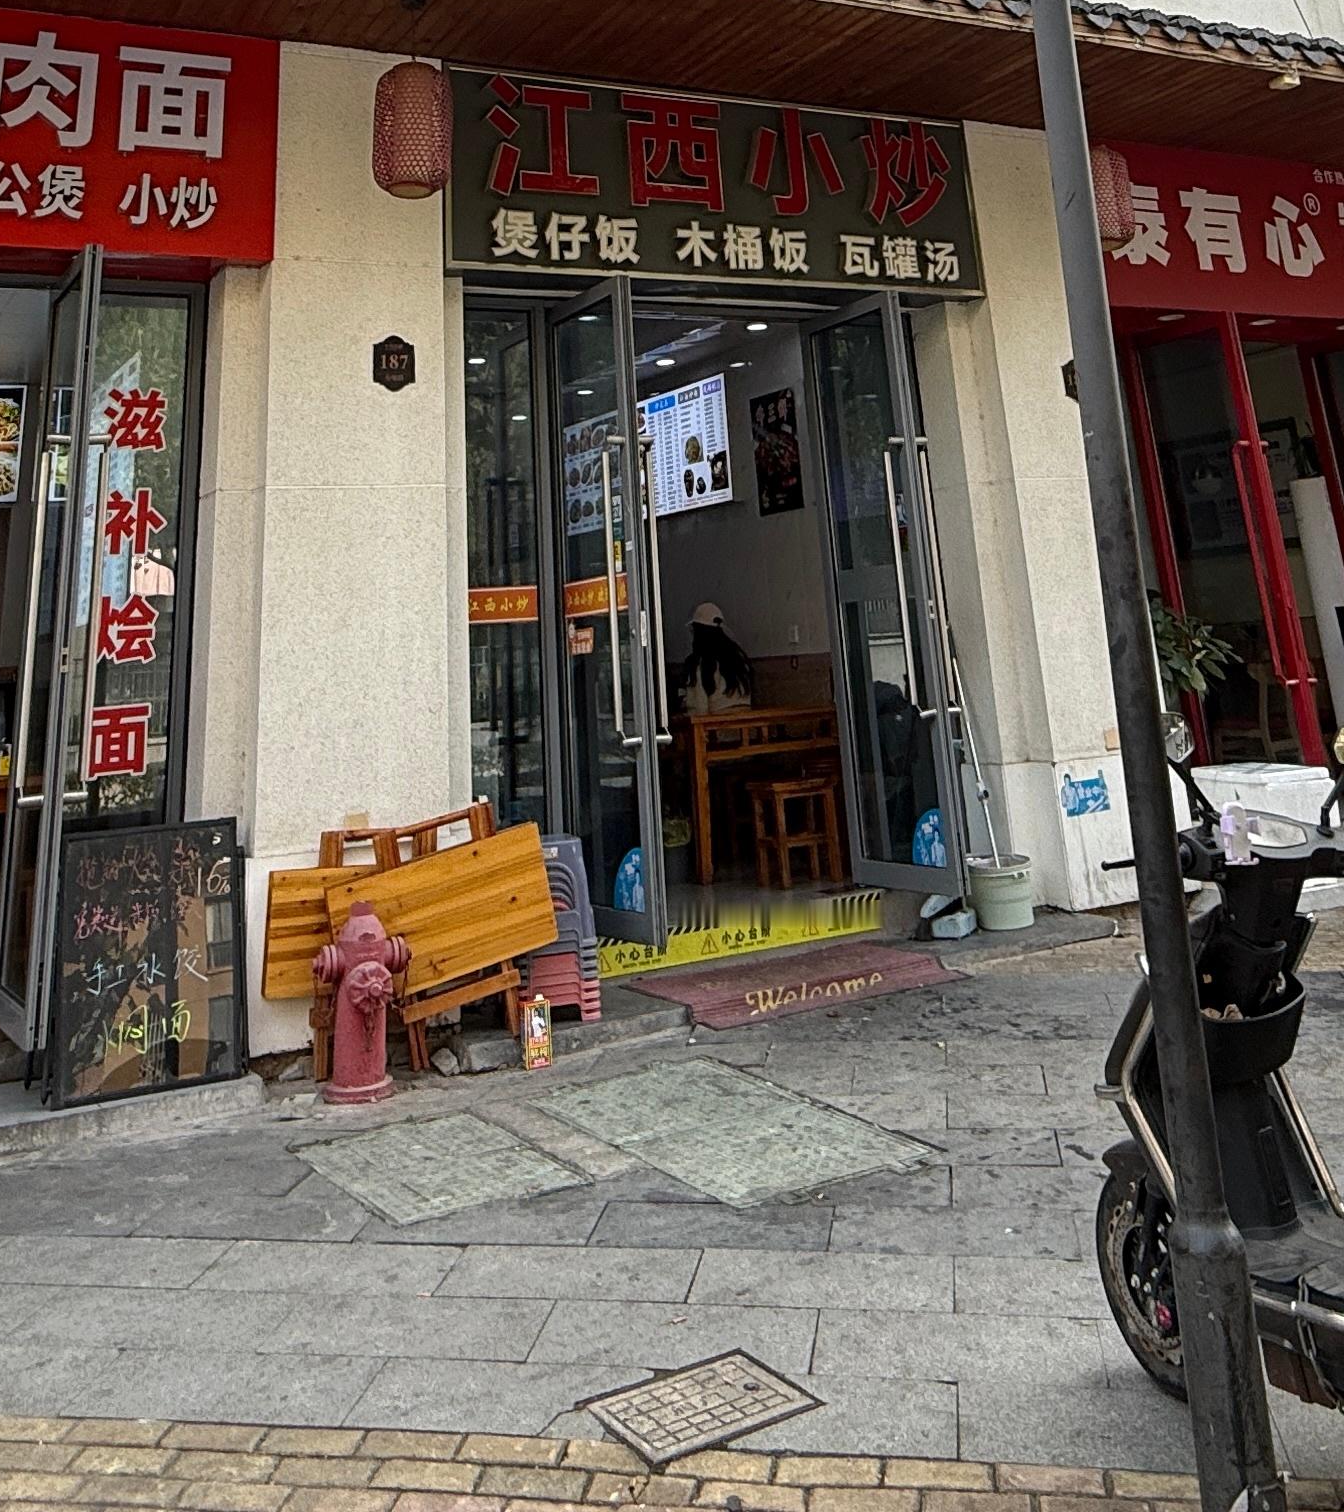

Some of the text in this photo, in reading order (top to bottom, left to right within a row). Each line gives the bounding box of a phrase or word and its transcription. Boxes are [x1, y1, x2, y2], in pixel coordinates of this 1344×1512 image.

[484, 73, 953, 228] 江西小炒
[118, 173, 218, 231] 小炒
[489, 207, 960, 285] 煲仔饭 木桶饭 瓦罐汤
[381, 354, 409, 369] 187
[88, 387, 168, 781] 滋补烩面
[86, 945, 209, 996] 手工水饺
